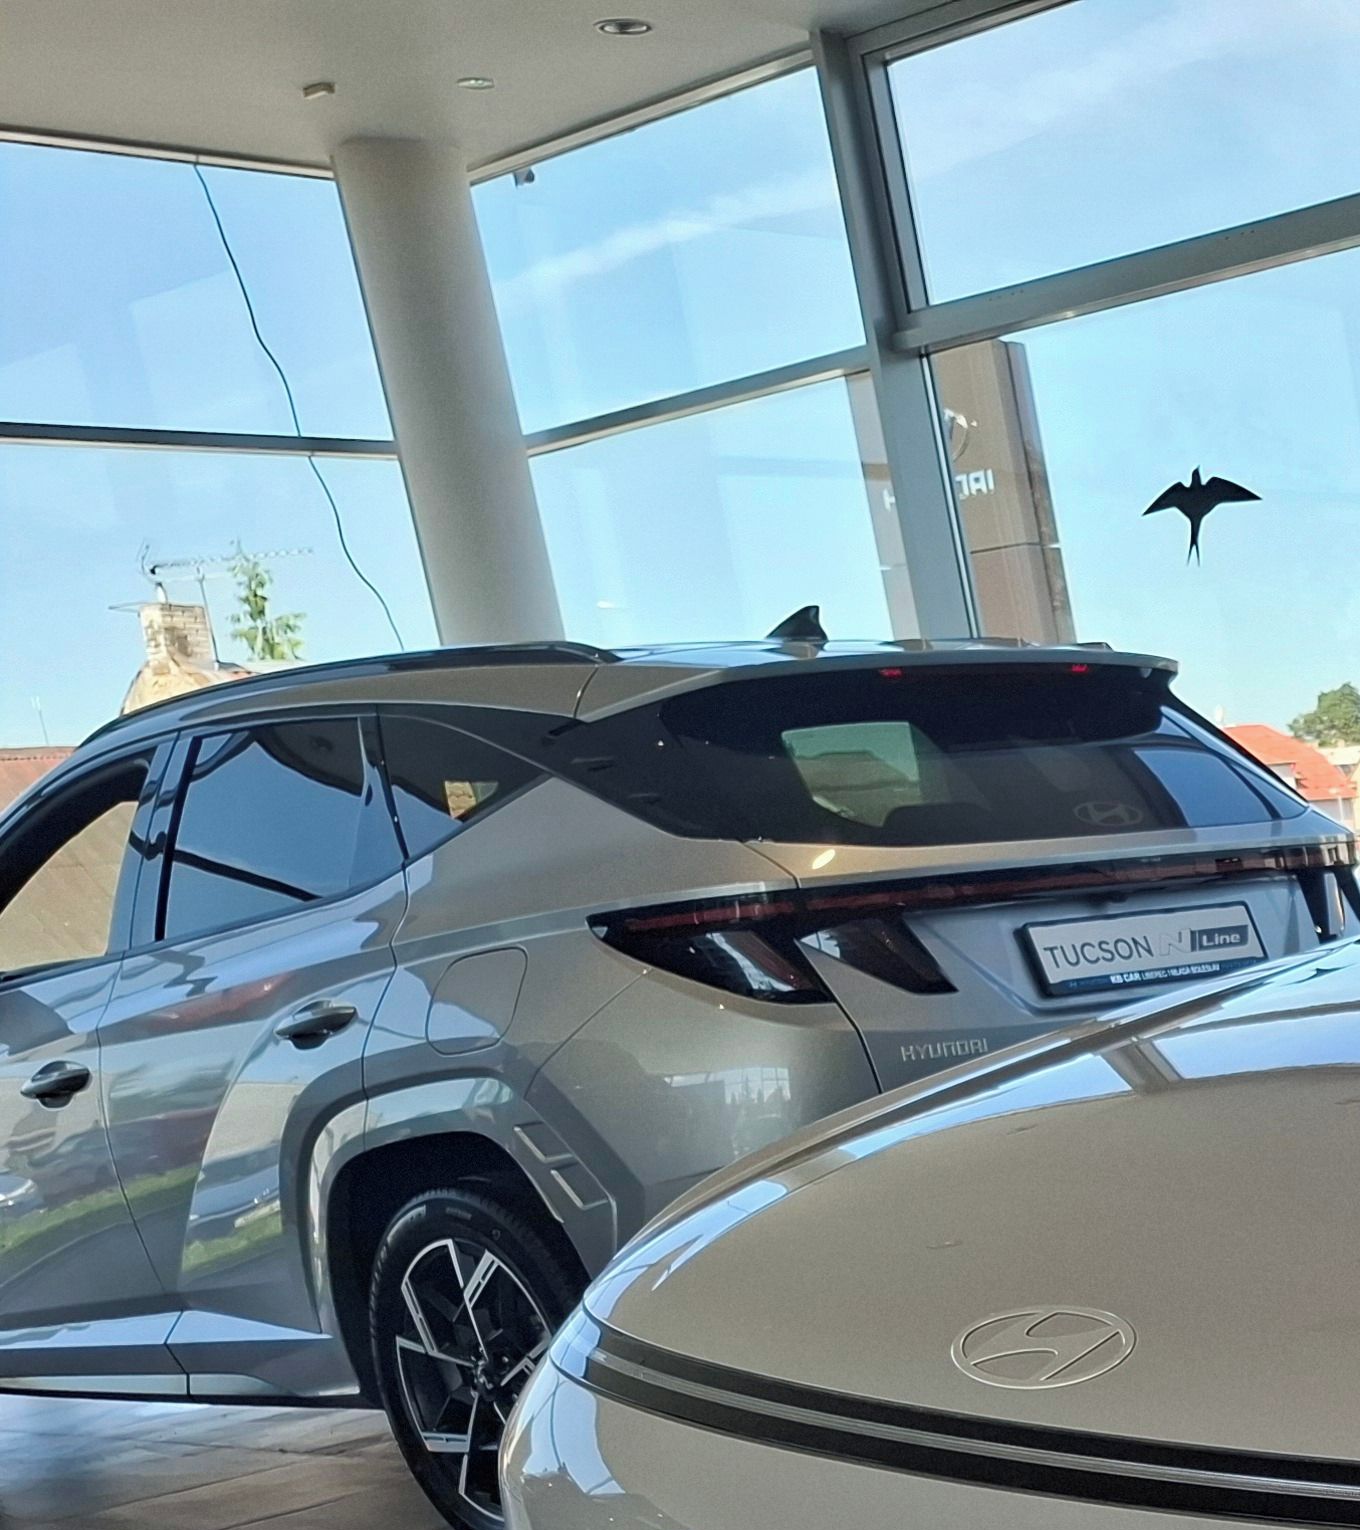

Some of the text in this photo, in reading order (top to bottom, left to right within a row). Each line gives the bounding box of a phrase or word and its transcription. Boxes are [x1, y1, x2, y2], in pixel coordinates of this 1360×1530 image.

[1043, 935, 1155, 969] TUCSON
[1202, 930, 1241, 947] Line
[900, 1038, 988, 1061] HYUNDAI
